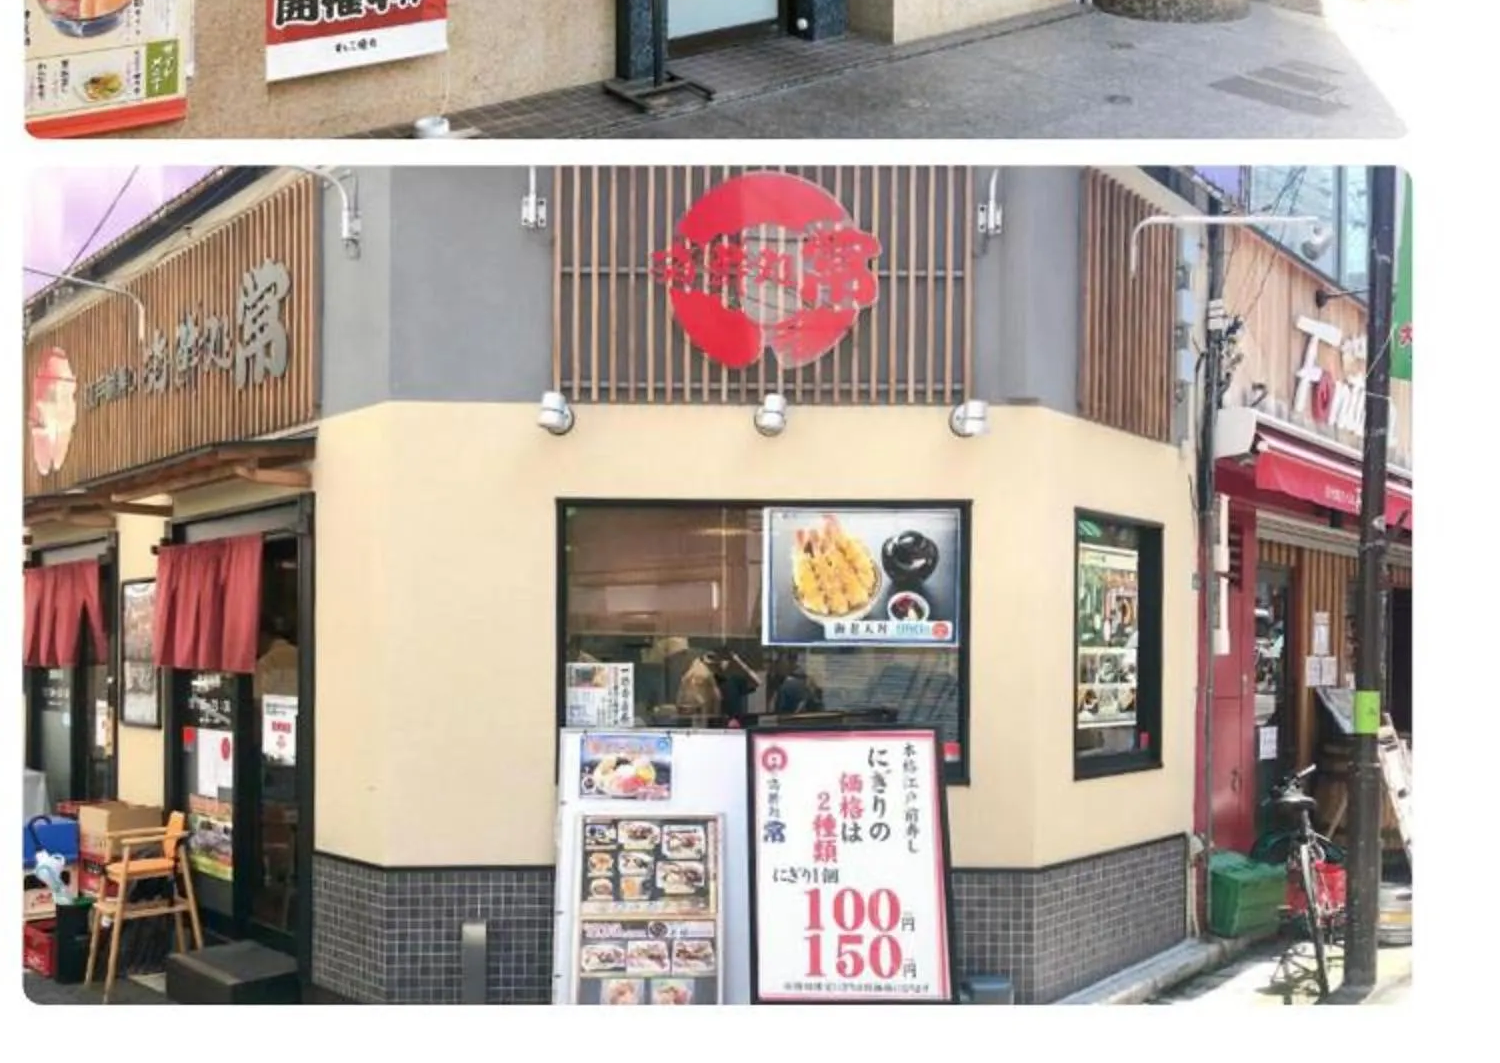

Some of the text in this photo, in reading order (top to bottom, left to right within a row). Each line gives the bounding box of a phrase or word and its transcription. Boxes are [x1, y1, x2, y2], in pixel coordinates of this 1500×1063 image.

[812, 792, 838, 864] 2種類
[840, 772, 865, 843] 価格は
[867, 746, 892, 843] にぎりの
[804, 887, 916, 932] 100円
[805, 933, 917, 979] 150円
